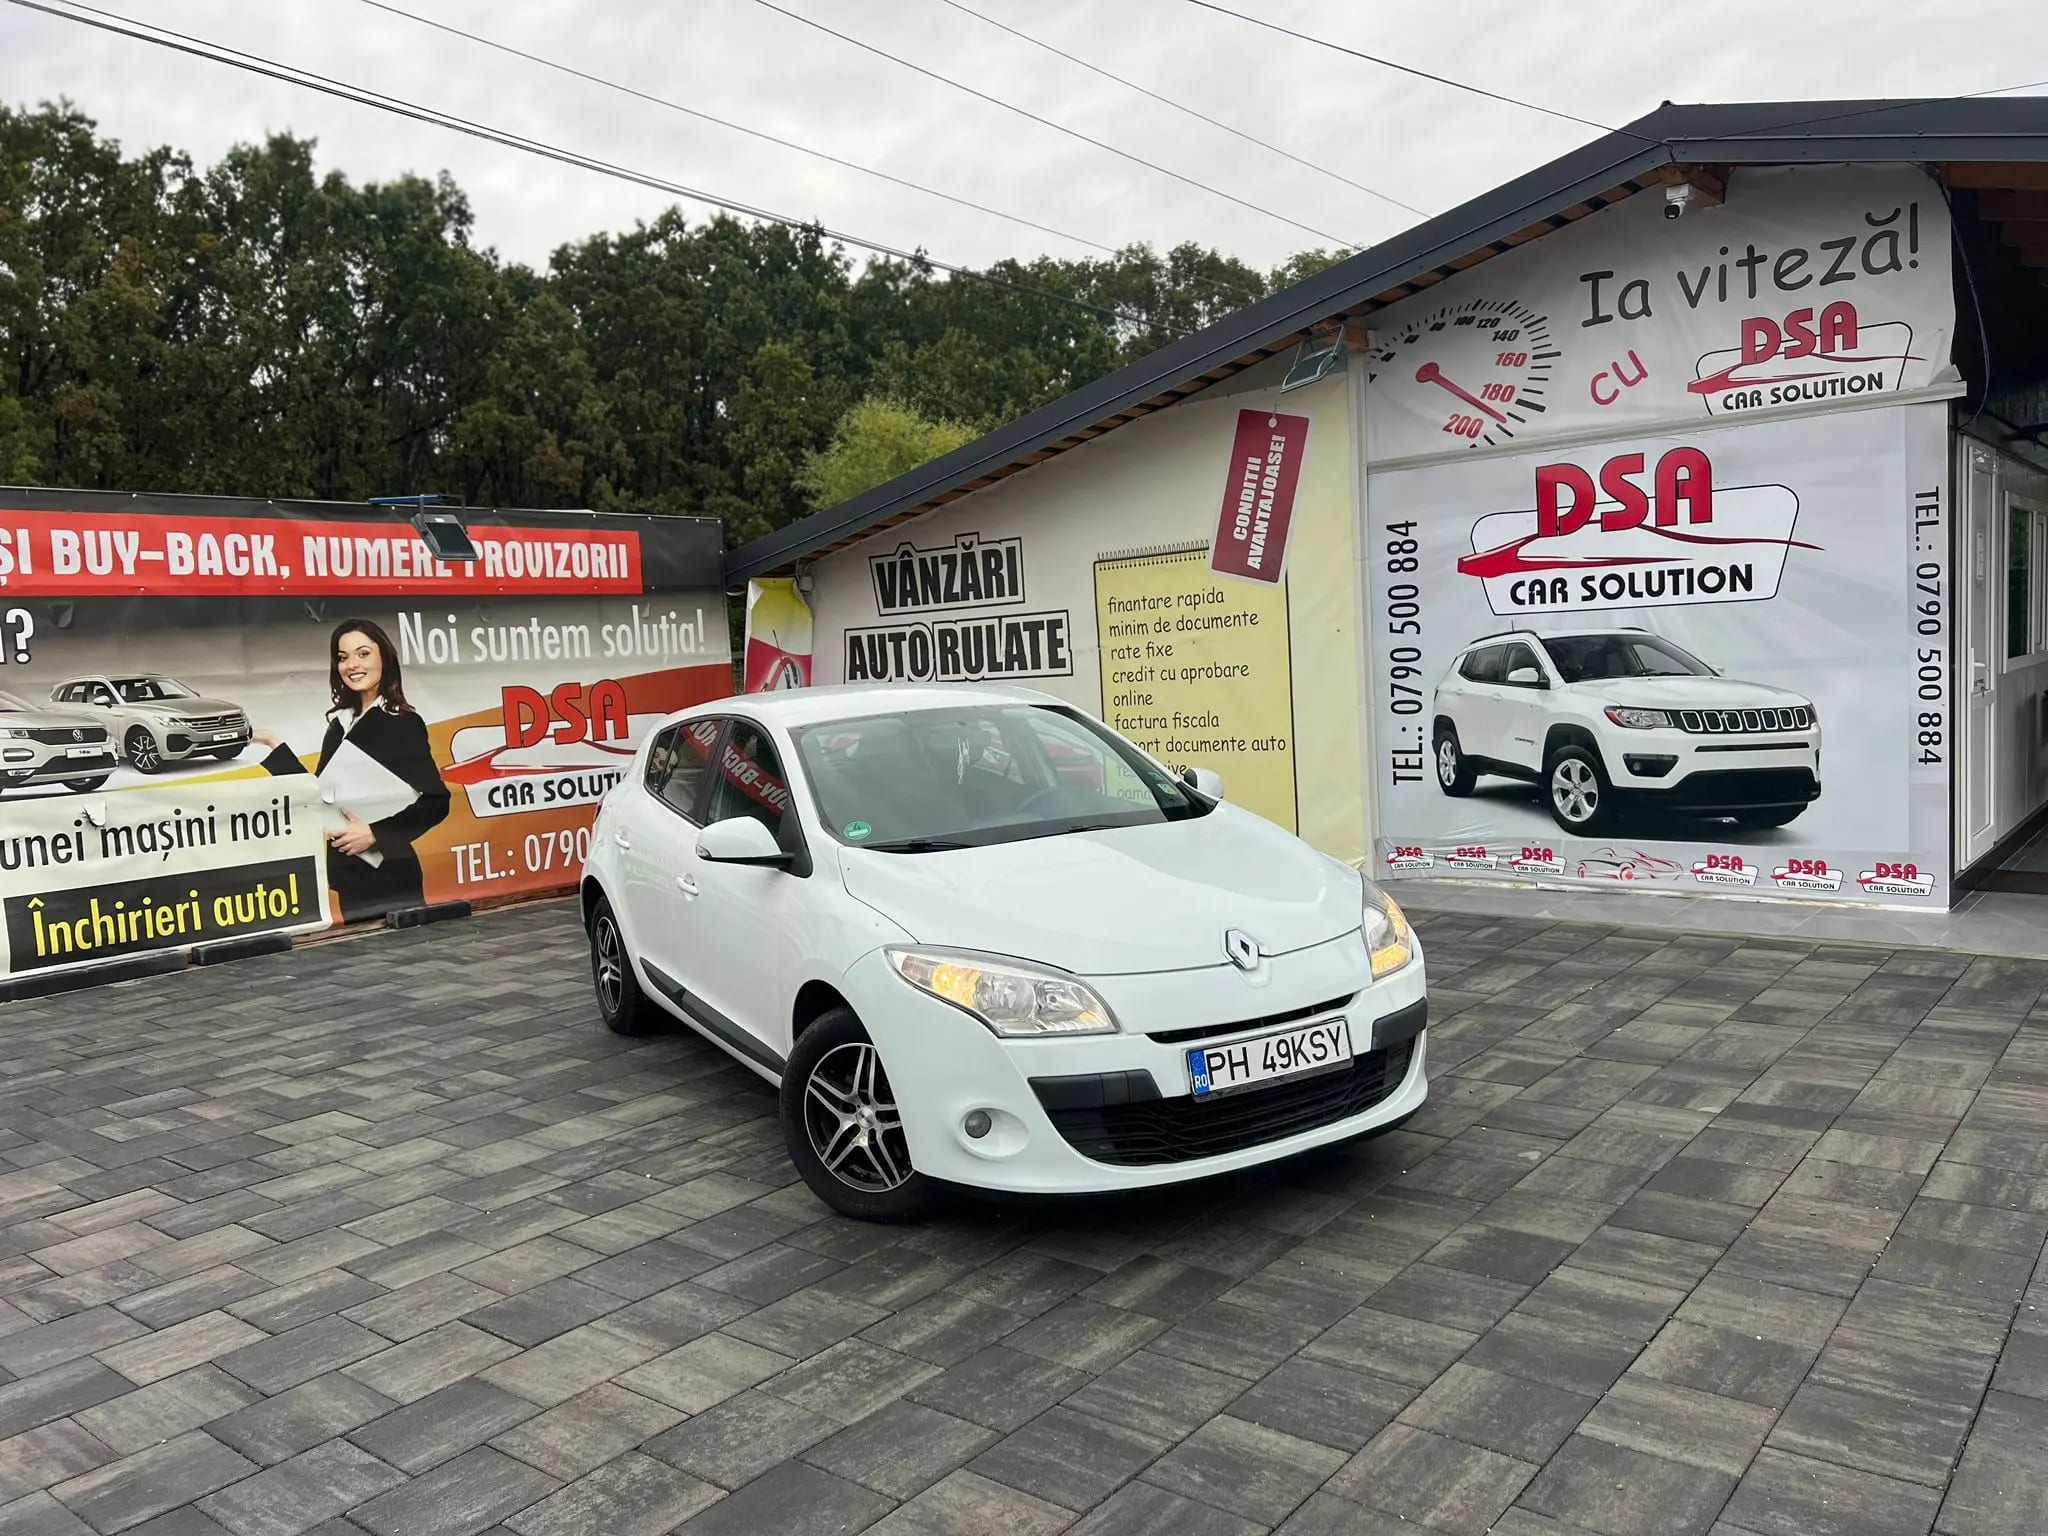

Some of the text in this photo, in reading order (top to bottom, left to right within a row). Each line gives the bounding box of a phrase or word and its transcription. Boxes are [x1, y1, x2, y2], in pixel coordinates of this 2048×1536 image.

[1580, 202, 1919, 328] Ia viteză!
[1476, 317, 1502, 329] 120
[1492, 329, 1520, 342] 140
[1741, 301, 1858, 366] DSA
[1494, 352, 1528, 368] 160
[1590, 349, 1649, 406] cu
[1480, 383, 1516, 403] 180
[1722, 372, 1883, 411] CAR SOLUTION
[1443, 413, 1484, 439] 200
[1233, 456, 1262, 541] CONDITII
[1247, 434, 1286, 570] AVANTAJOASE!
[1535, 446, 1713, 537] DSA
[1386, 520, 1419, 573] 884
[874, 540, 1019, 609] VÂNZĂRI
[1510, 563, 1753, 606] CAR SOLUTION
[1108, 586, 1225, 615] finantare rapida
[1387, 584, 1421, 635] 500
[1916, 562, 1941, 636] 0790
[399, 604, 705, 664] Noi suntem soluția!
[1109, 610, 1259, 638] minim de documente
[848, 618, 1067, 681] AUTO RULATE
[1111, 641, 1174, 660] rate fixe
[1112, 661, 1250, 684] credit cu aprobare
[1389, 647, 1423, 715] 0790
[1917, 648, 1942, 701] 500
[501, 678, 629, 749] DSA
[1113, 690, 1154, 706] online
[1115, 710, 1220, 731] factura fiscala
[1918, 712, 1943, 766] 884
[1166, 735, 1247, 753] documente
[1252, 735, 1286, 752] auto
[488, 782, 535, 808] CAR
[0, 795, 293, 870] unei mașini noi!
[1522, 847, 1553, 861] DSA
[1706, 854, 1743, 871] DSA
[1788, 859, 1827, 876] DSA
[1875, 862, 1918, 880] DSA
[1869, 884, 1926, 894] CAR SOLUTION
[27, 872, 300, 957] Închirieri auto!
[1206, 1025, 1341, 1085] PH 49KSY
[1195, 1074, 1208, 1089] RO
